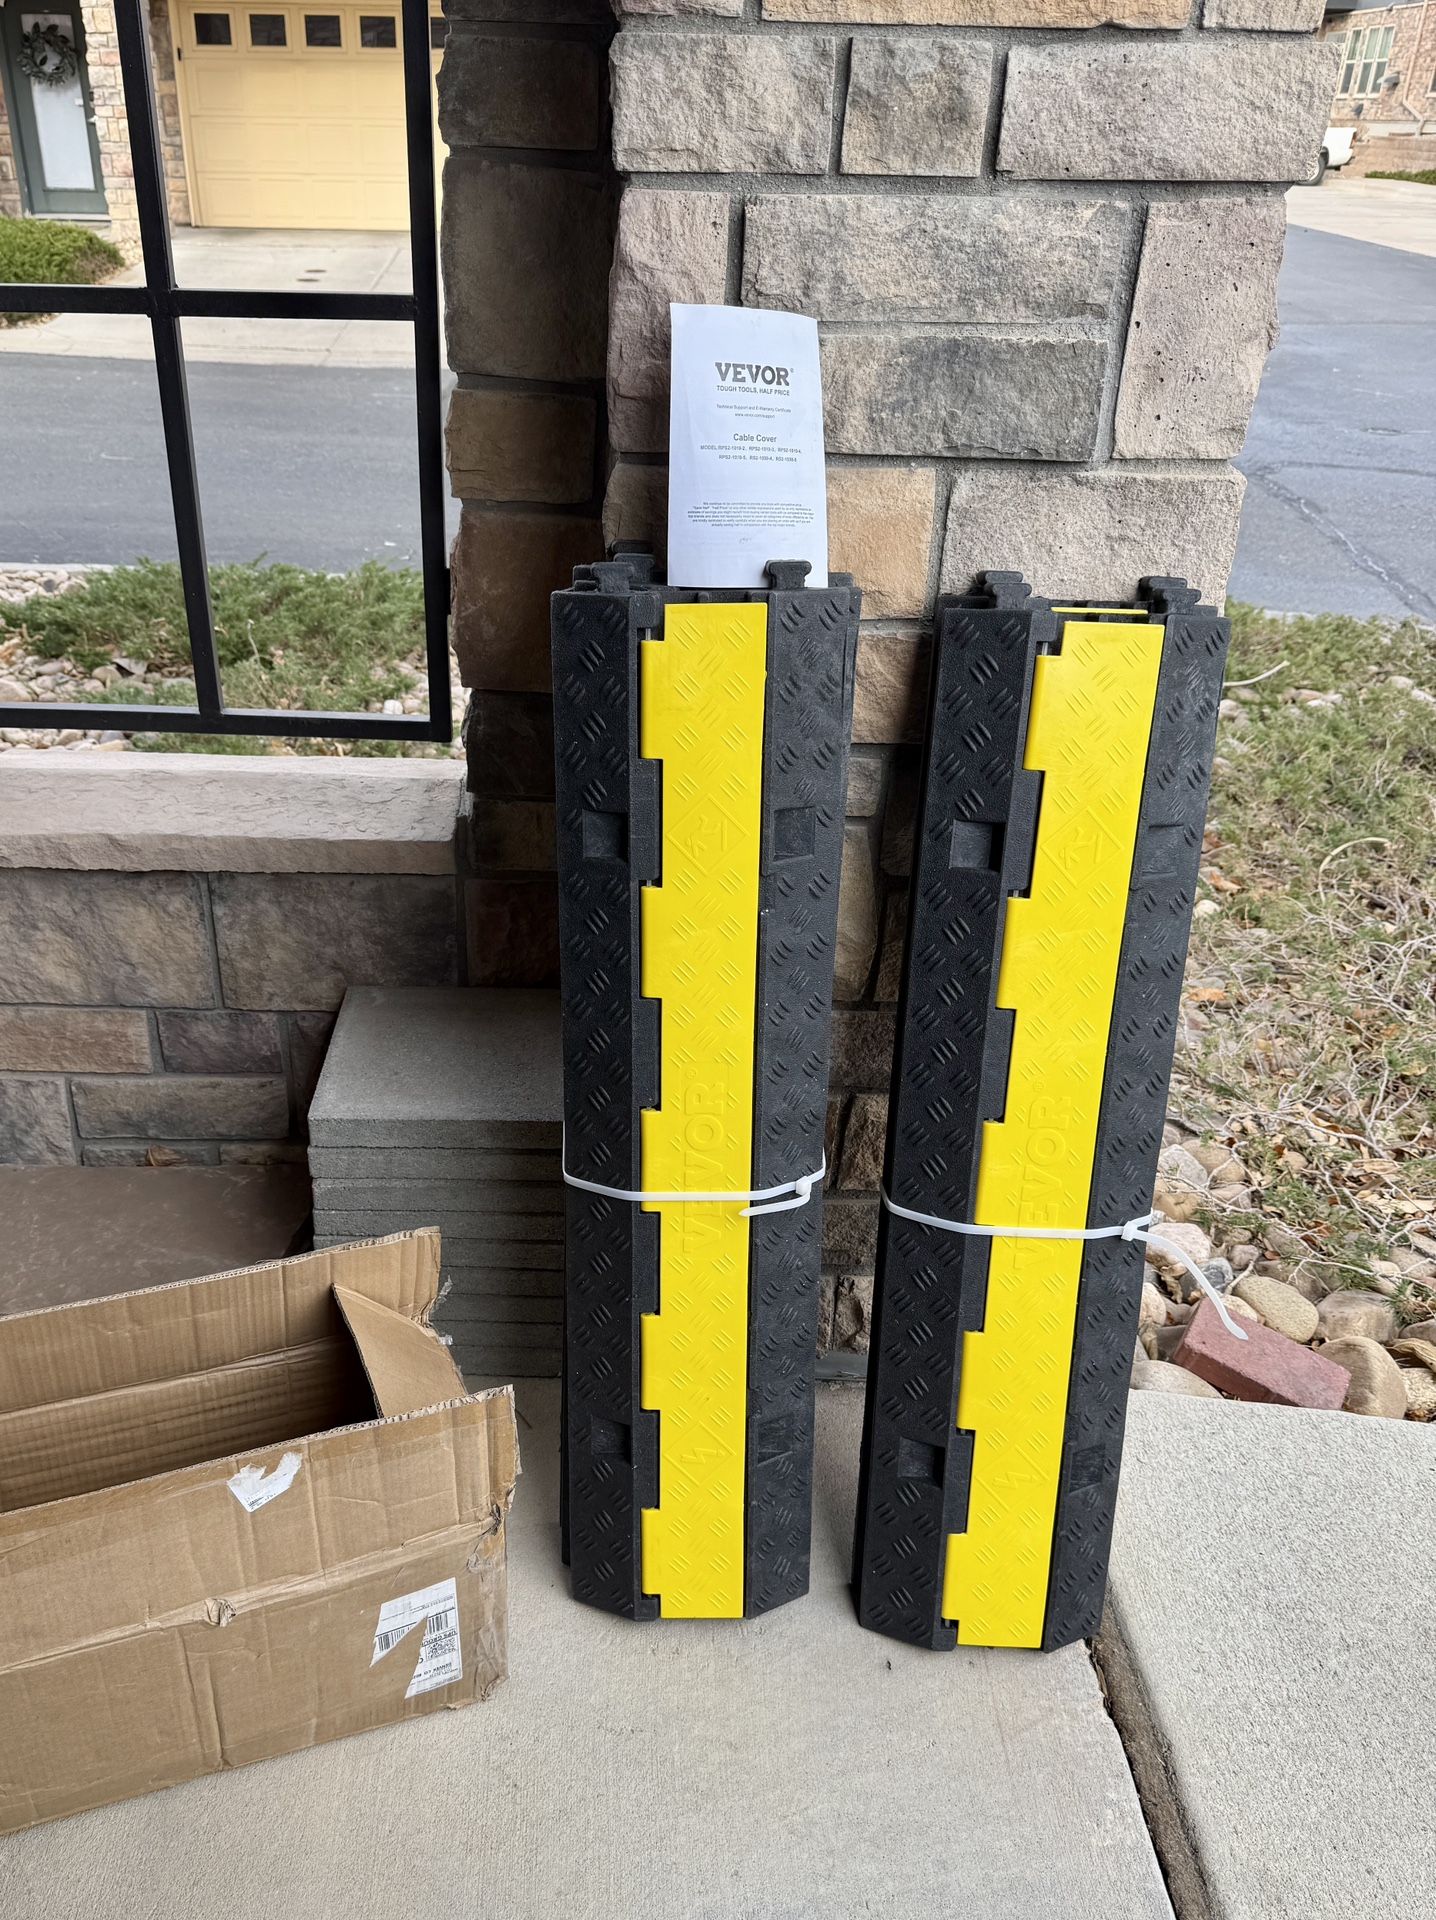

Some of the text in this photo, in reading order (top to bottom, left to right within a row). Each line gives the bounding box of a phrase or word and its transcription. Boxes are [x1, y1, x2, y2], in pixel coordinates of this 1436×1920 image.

[715, 362, 789, 386] VEVOR
[738, 386, 758, 394] TOOLS,
[733, 433, 777, 443] Cable Cover
